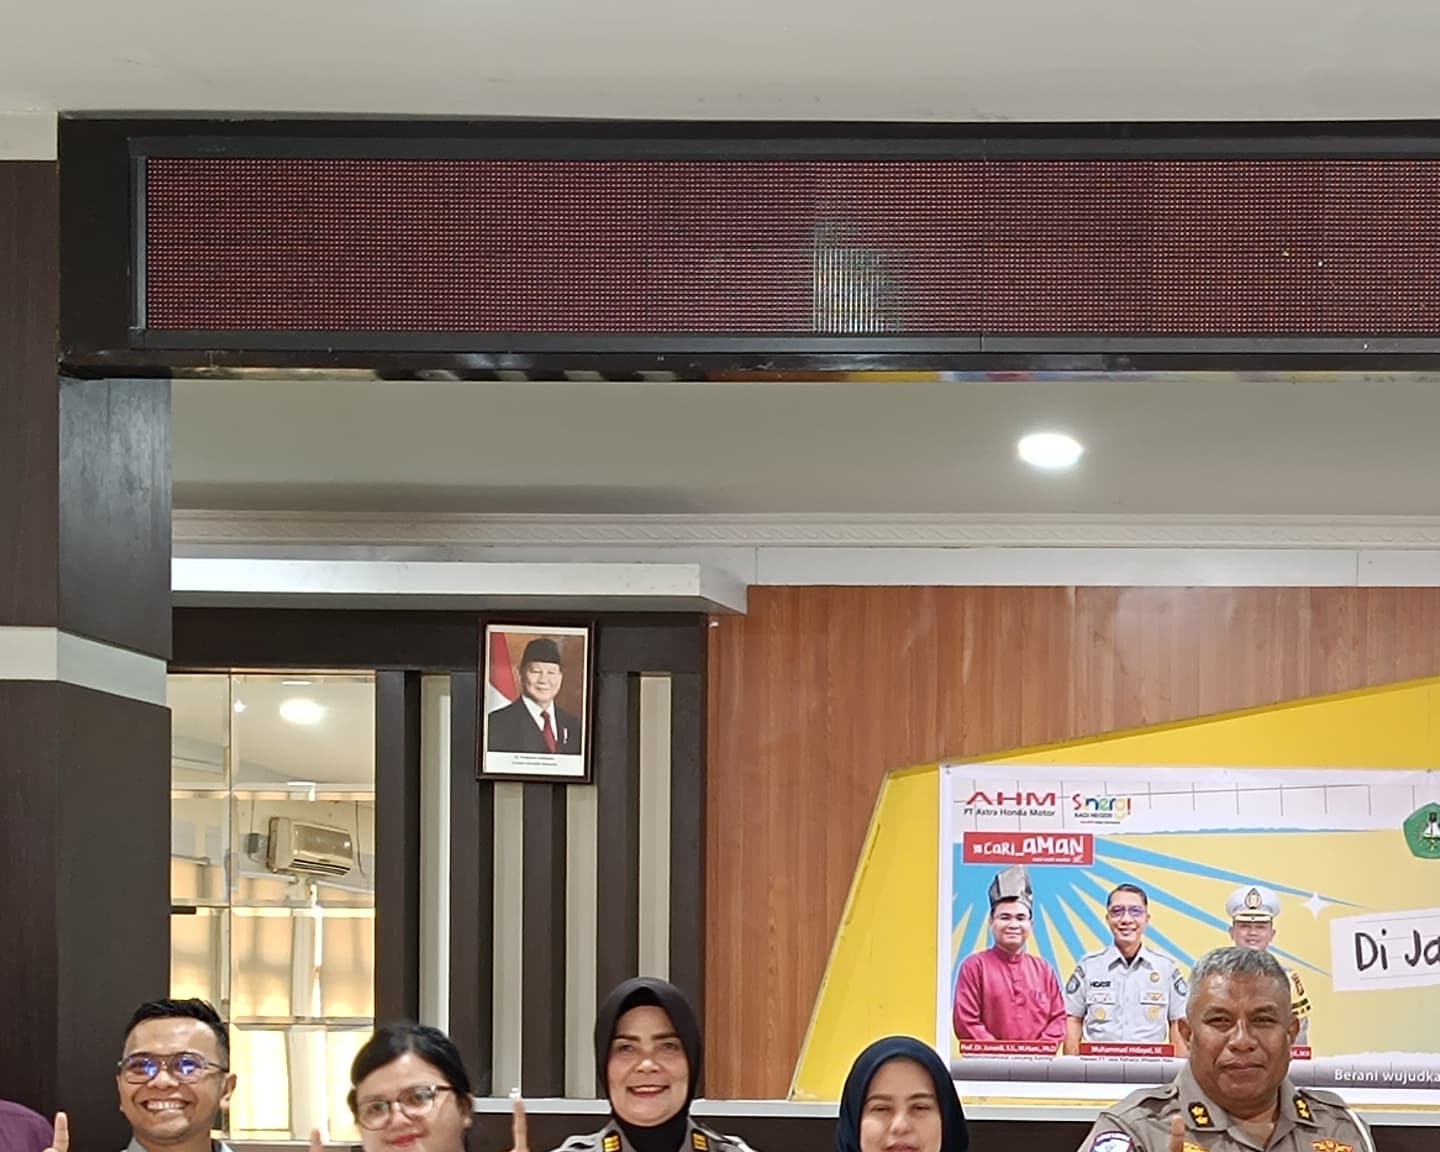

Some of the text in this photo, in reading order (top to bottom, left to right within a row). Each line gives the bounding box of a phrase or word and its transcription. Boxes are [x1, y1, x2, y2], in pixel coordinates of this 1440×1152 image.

[966, 791, 1056, 806] AHM
[975, 808, 998, 816] Astra
[1029, 809, 1055, 817] Motor
[1354, 929, 1388, 972] Di
[1334, 1069, 1378, 1081] Berani
